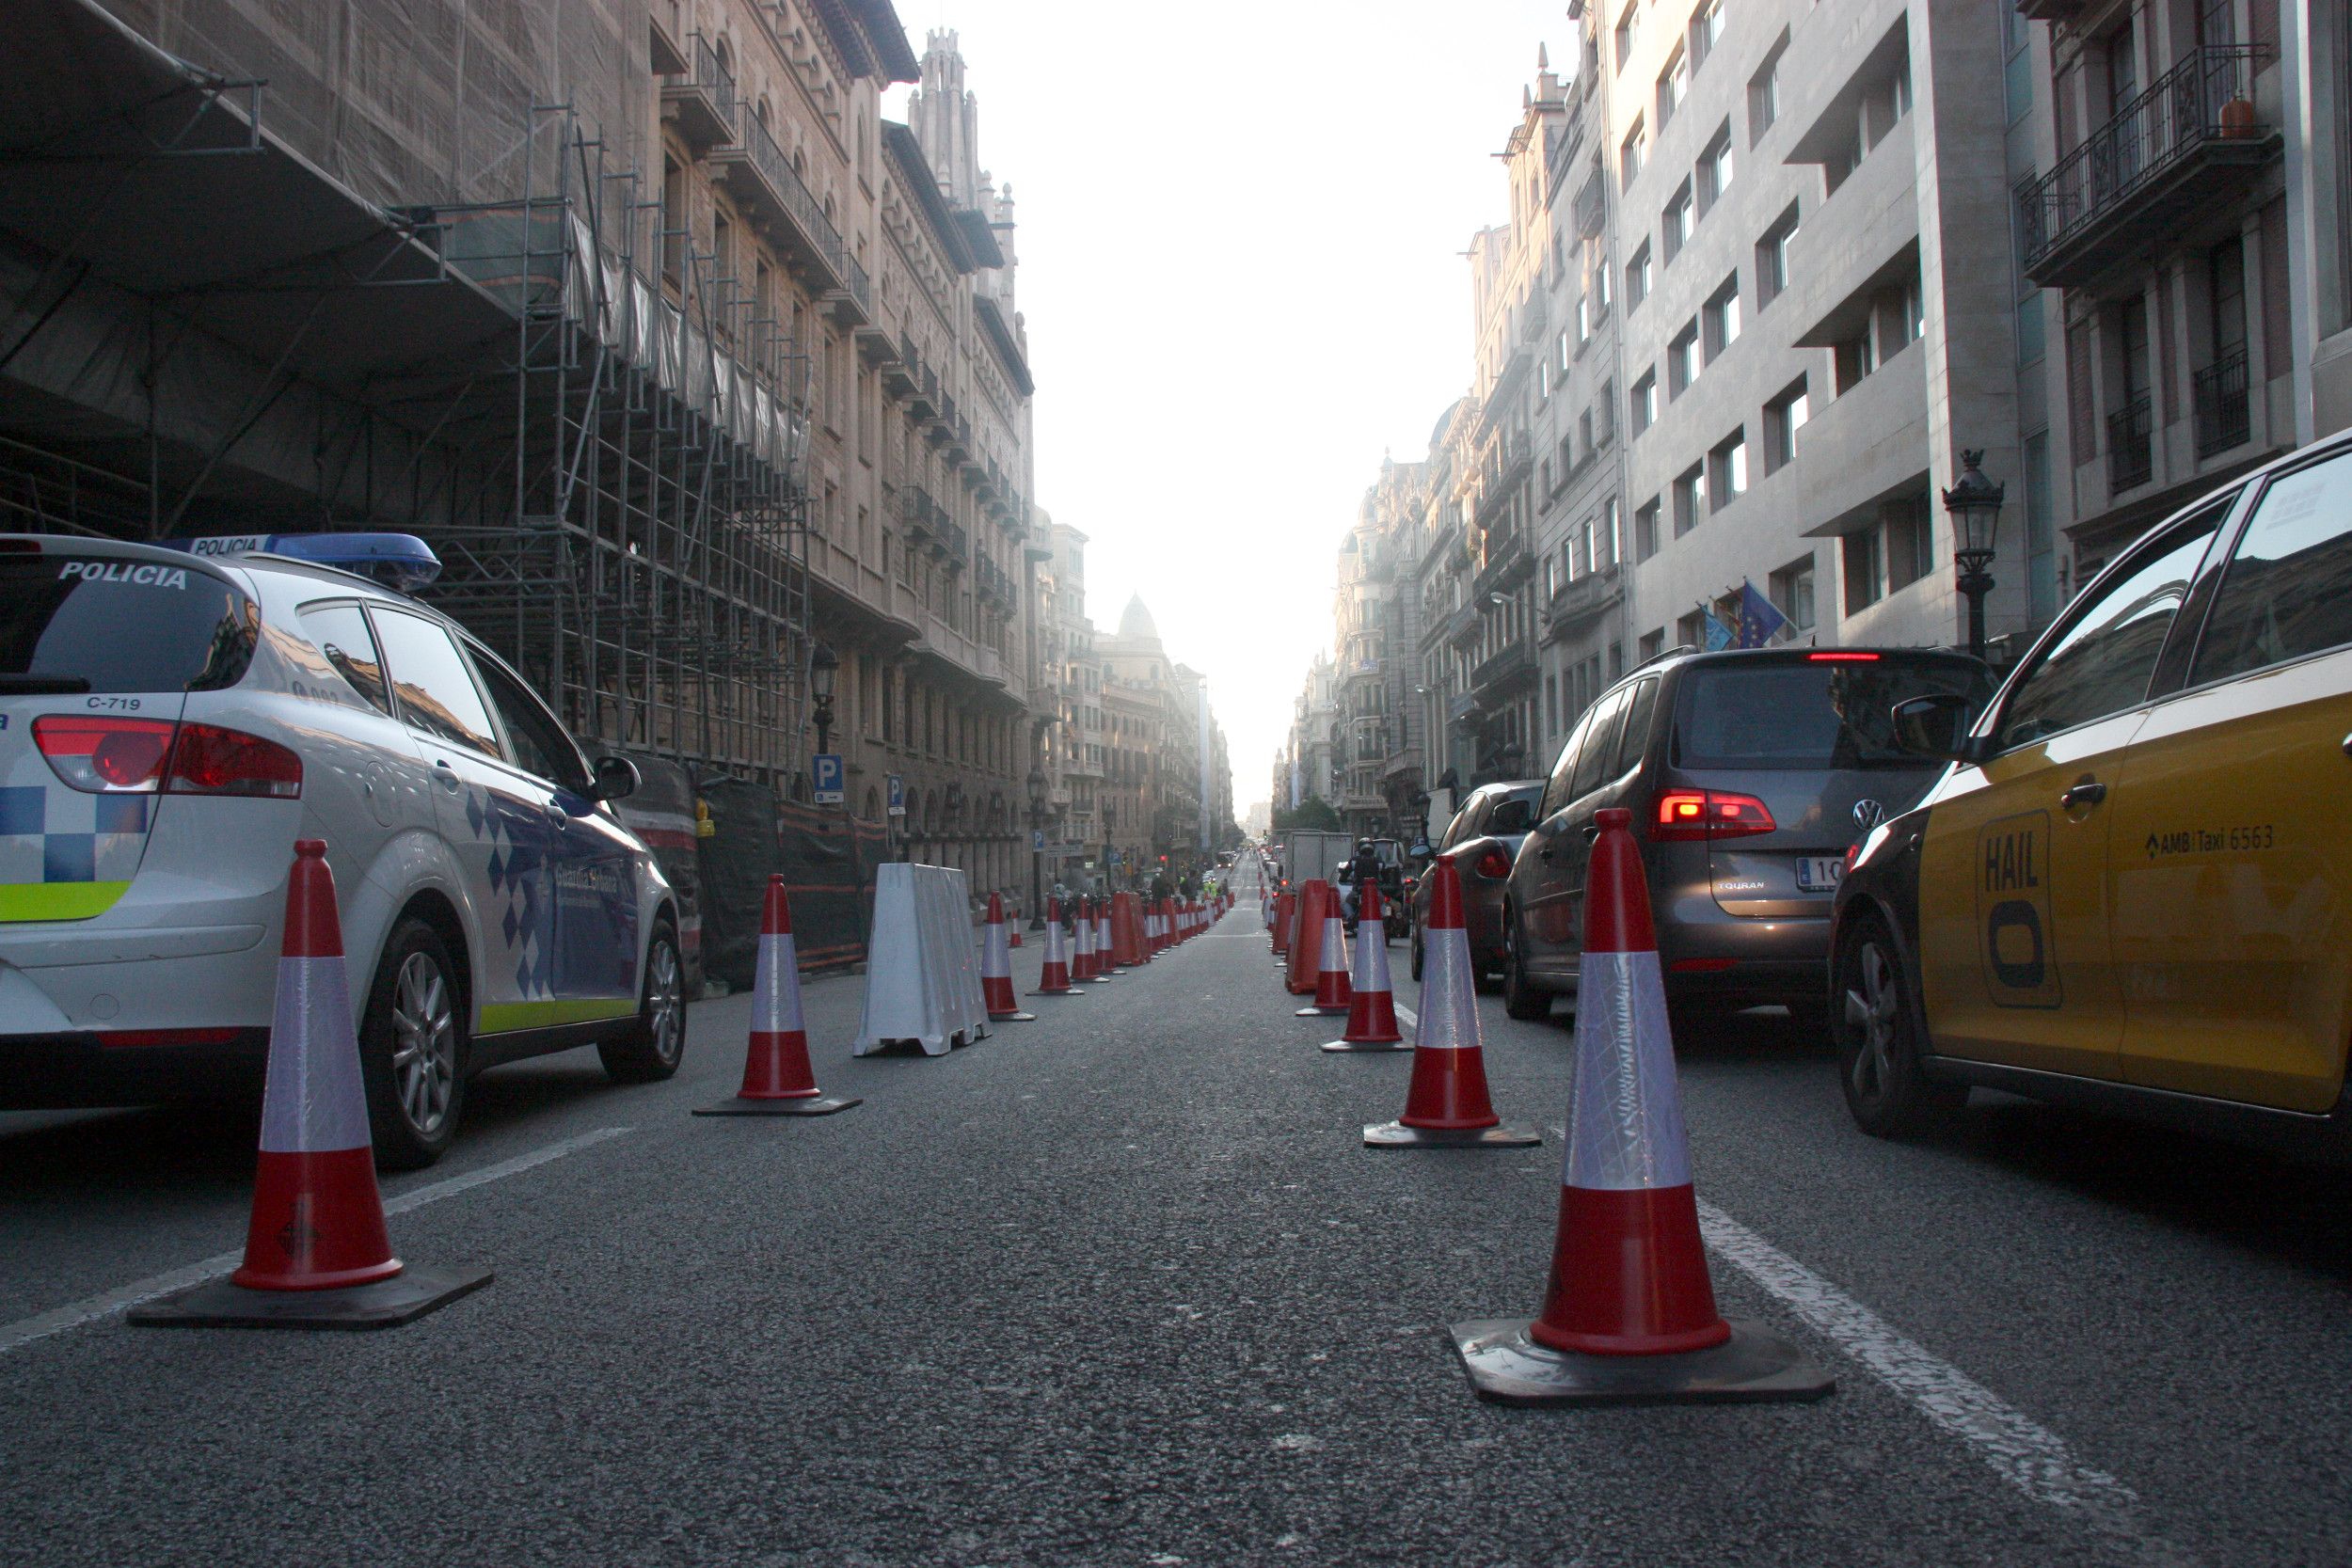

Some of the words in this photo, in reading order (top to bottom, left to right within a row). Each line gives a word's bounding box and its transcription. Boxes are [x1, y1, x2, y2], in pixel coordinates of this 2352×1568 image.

[195, 538, 257, 556] POLICIA
[58, 562, 186, 591] POLICIA
[87, 696, 141, 711] C-719
[818, 758, 837, 787] P
[891, 779, 900, 803] P
[2161, 831, 2191, 855] AMB
[2197, 829, 2224, 853] Taxi
[2230, 824, 2273, 850] 6563
[1987, 830, 2039, 892] HAIL
[1718, 881, 1764, 890] TOURAN
